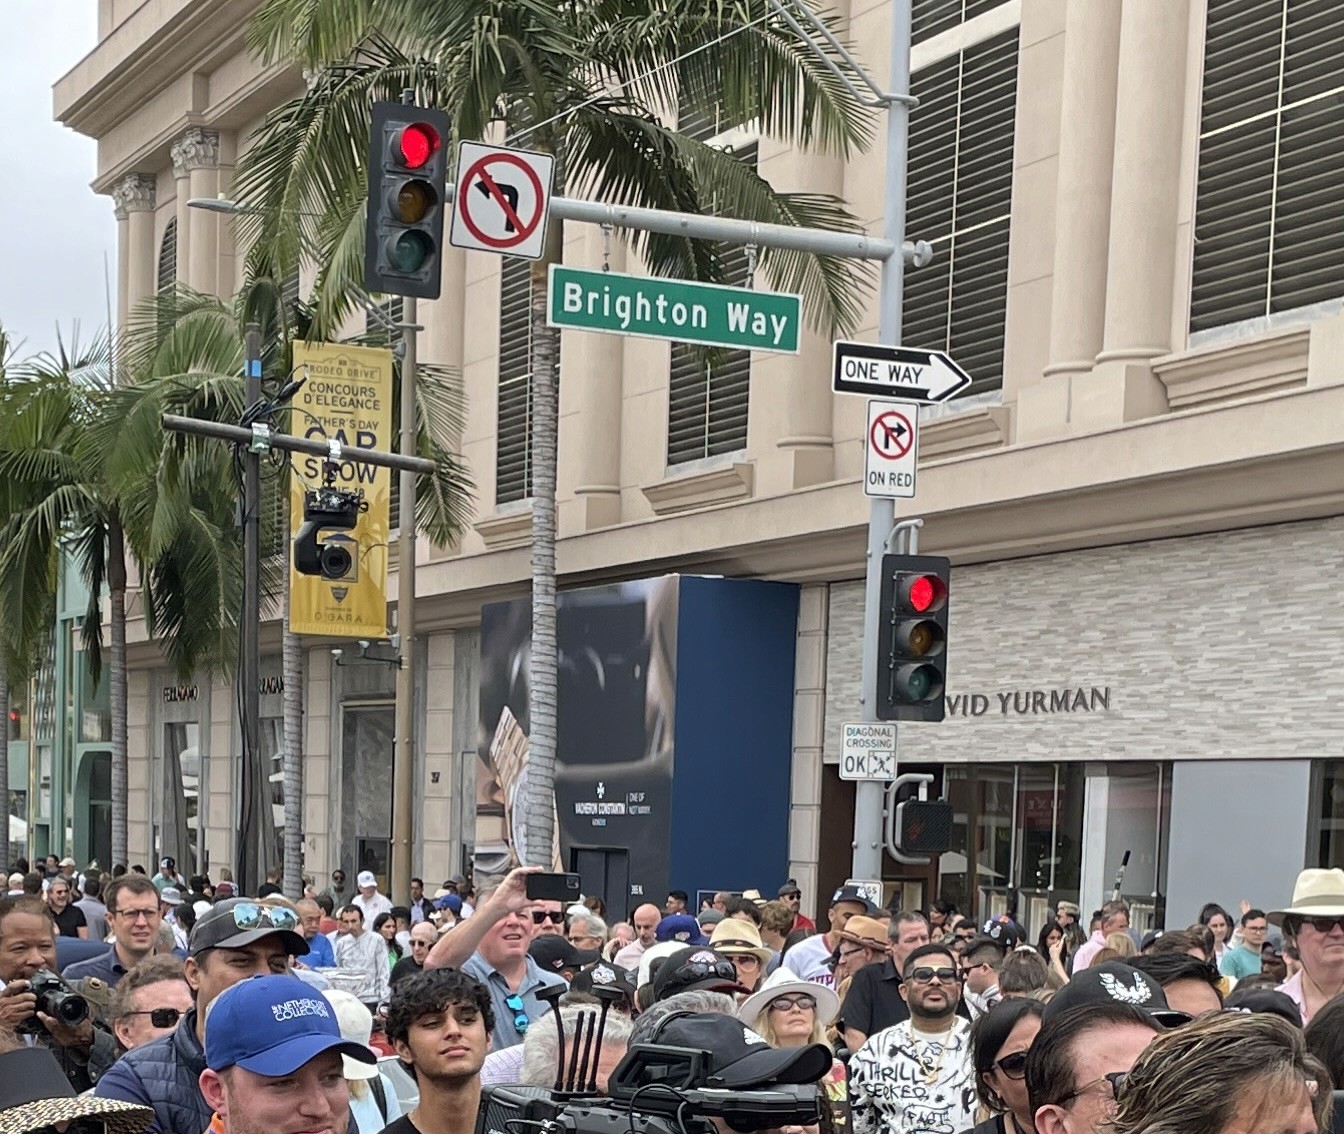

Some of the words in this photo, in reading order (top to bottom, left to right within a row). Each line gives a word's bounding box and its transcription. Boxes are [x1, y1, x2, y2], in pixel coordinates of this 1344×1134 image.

[563, 282, 707, 328] Brighton
[727, 303, 788, 345] Way
[845, 359, 879, 381] ONE
[887, 363, 924, 384] WAY
[309, 381, 376, 398] CONCOURS
[304, 393, 381, 411] D'ELEGANCE
[304, 415, 356, 429] FATHER'S
[358, 420, 379, 430] DAY
[304, 458, 377, 484] SOW
[869, 471, 886, 485] ON
[889, 473, 913, 488] RED
[945, 693, 991, 717] VID
[996, 686, 1112, 715] YURMAN
[846, 727, 893, 738] DIAGONAL
[846, 738, 892, 749] CROSSING
[845, 755, 866, 773] OK
[857, 1056, 926, 1085] THRILL
